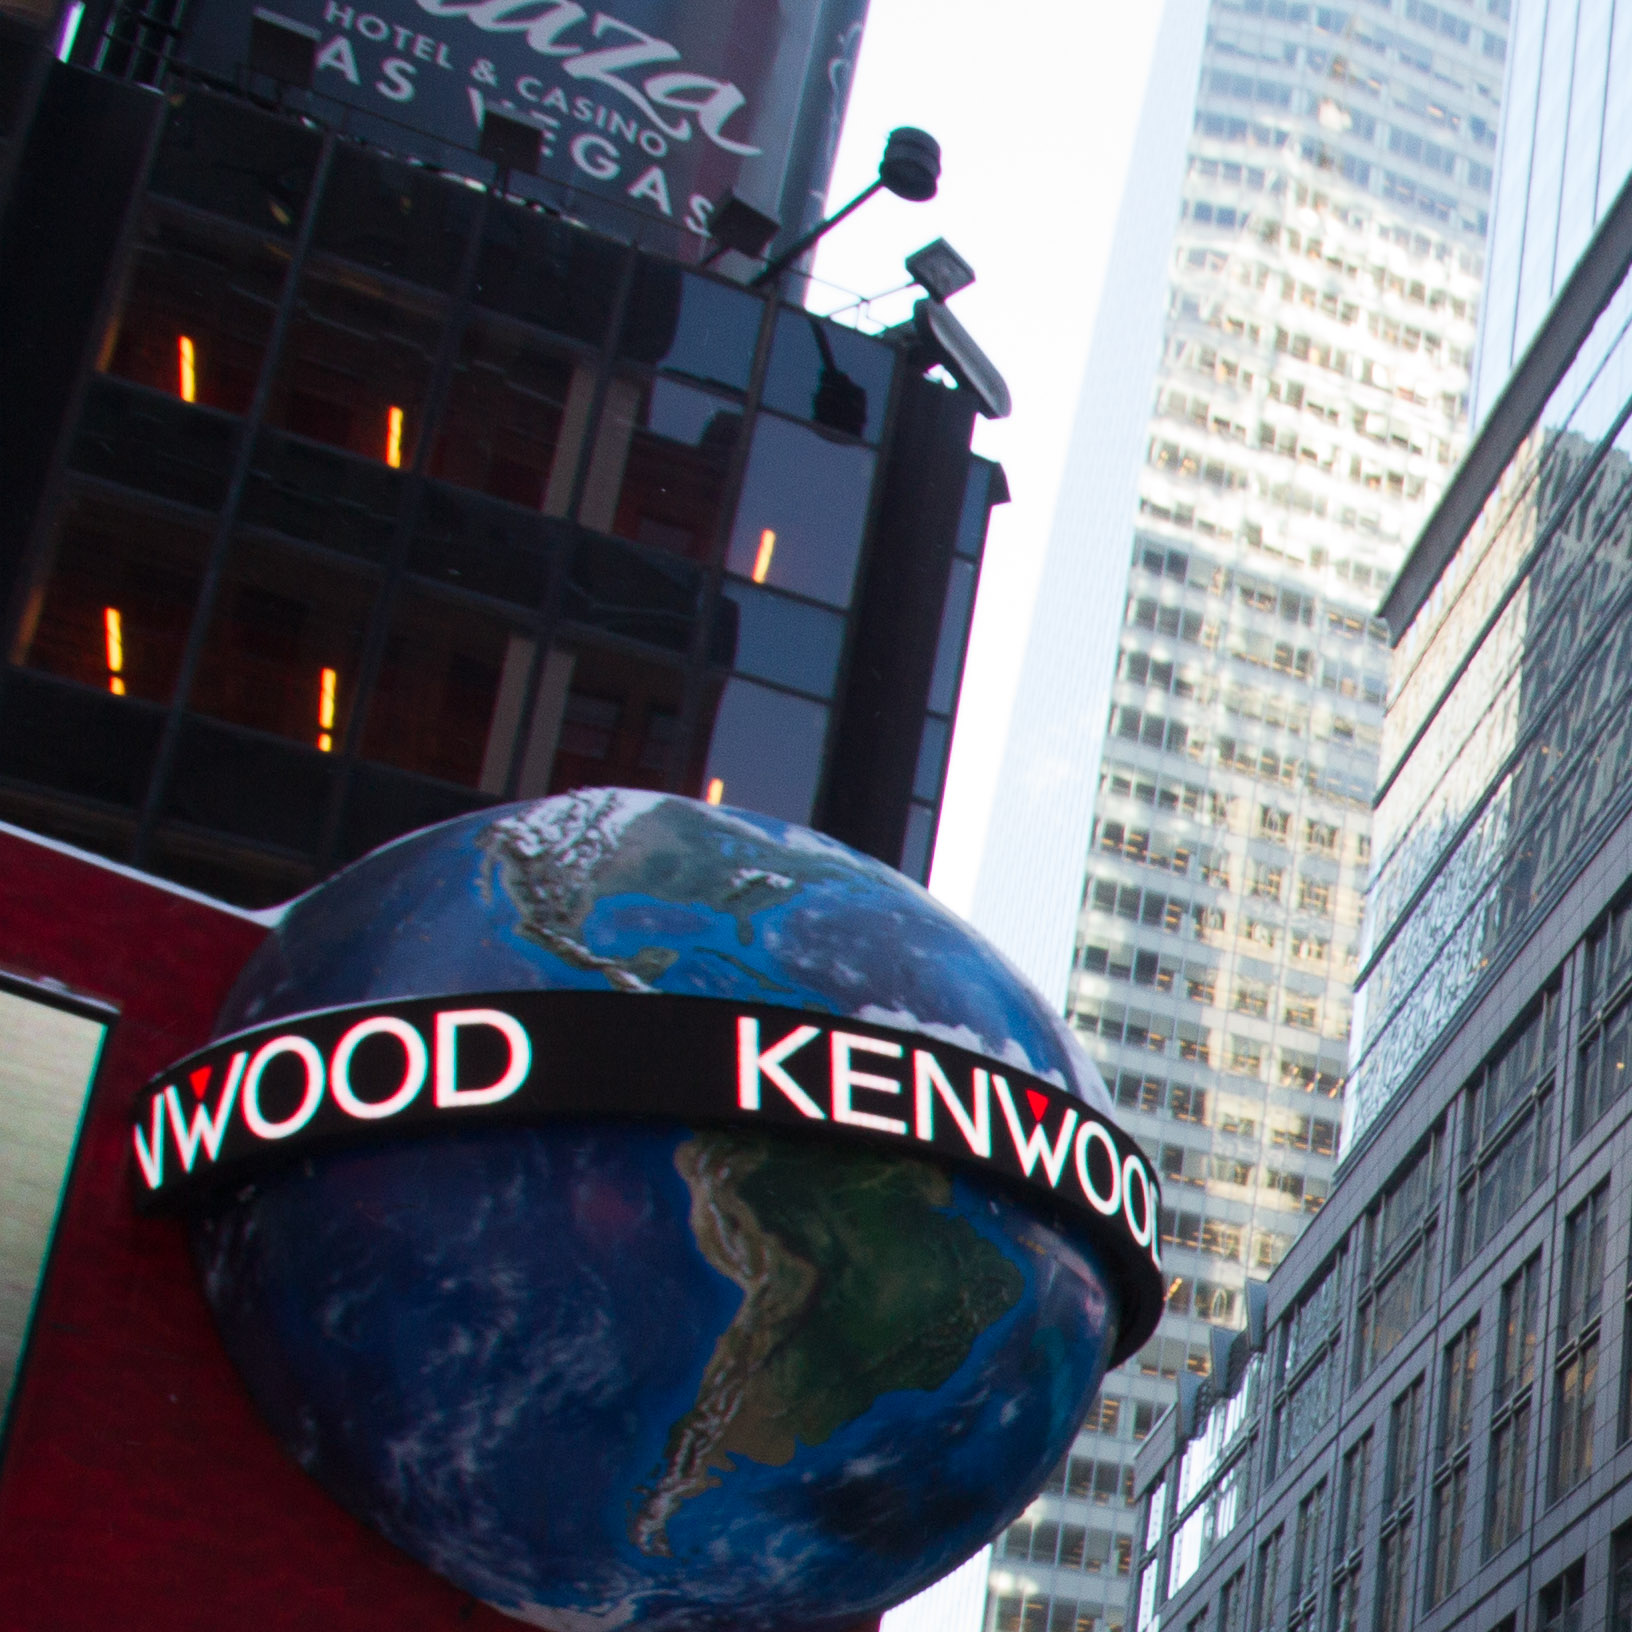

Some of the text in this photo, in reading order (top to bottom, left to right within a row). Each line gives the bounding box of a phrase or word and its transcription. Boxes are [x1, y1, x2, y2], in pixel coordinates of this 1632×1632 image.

[315, 34, 417, 101] AS
[323, 0, 668, 158] HOTEL & CASINO
